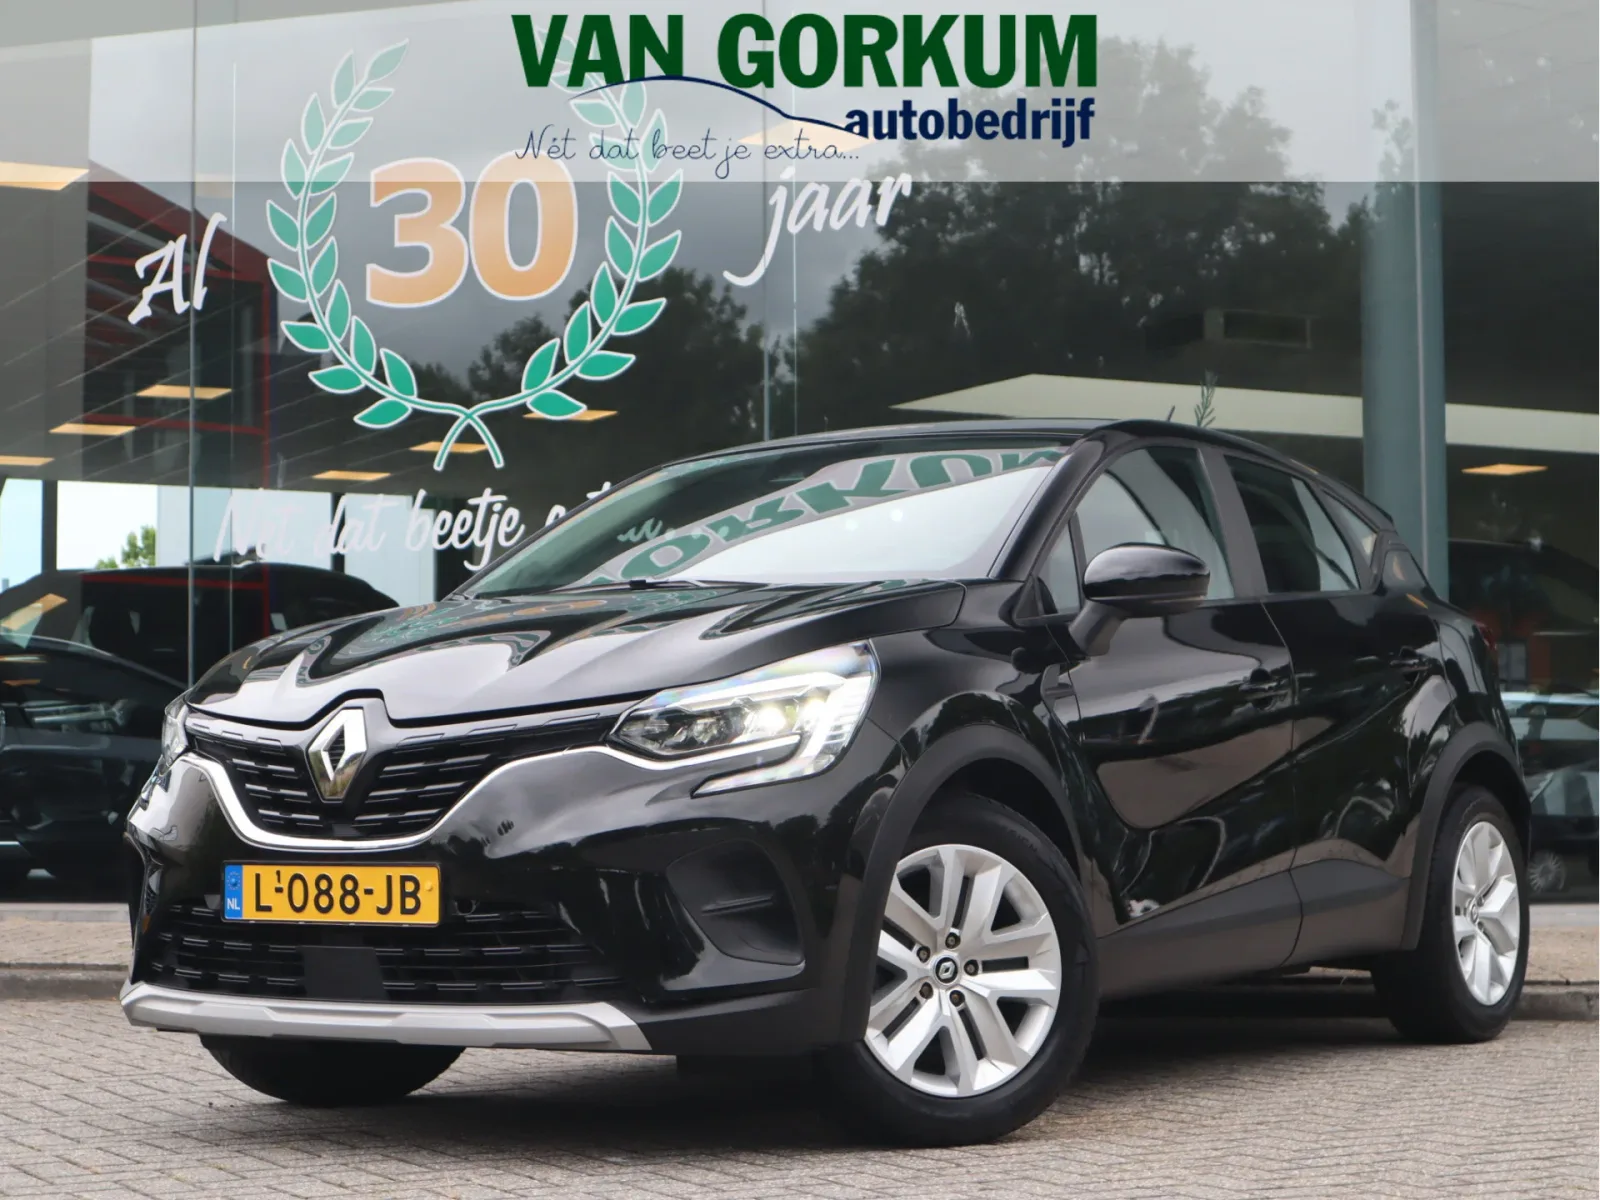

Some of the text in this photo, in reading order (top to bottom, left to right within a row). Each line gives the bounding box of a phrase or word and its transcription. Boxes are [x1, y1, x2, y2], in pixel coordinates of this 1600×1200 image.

[128, 150, 913, 324] Al 30 jaar
[312, 493, 400, 558] dat
[403, 487, 526, 572] beetje
[226, 898, 240, 911] NL
